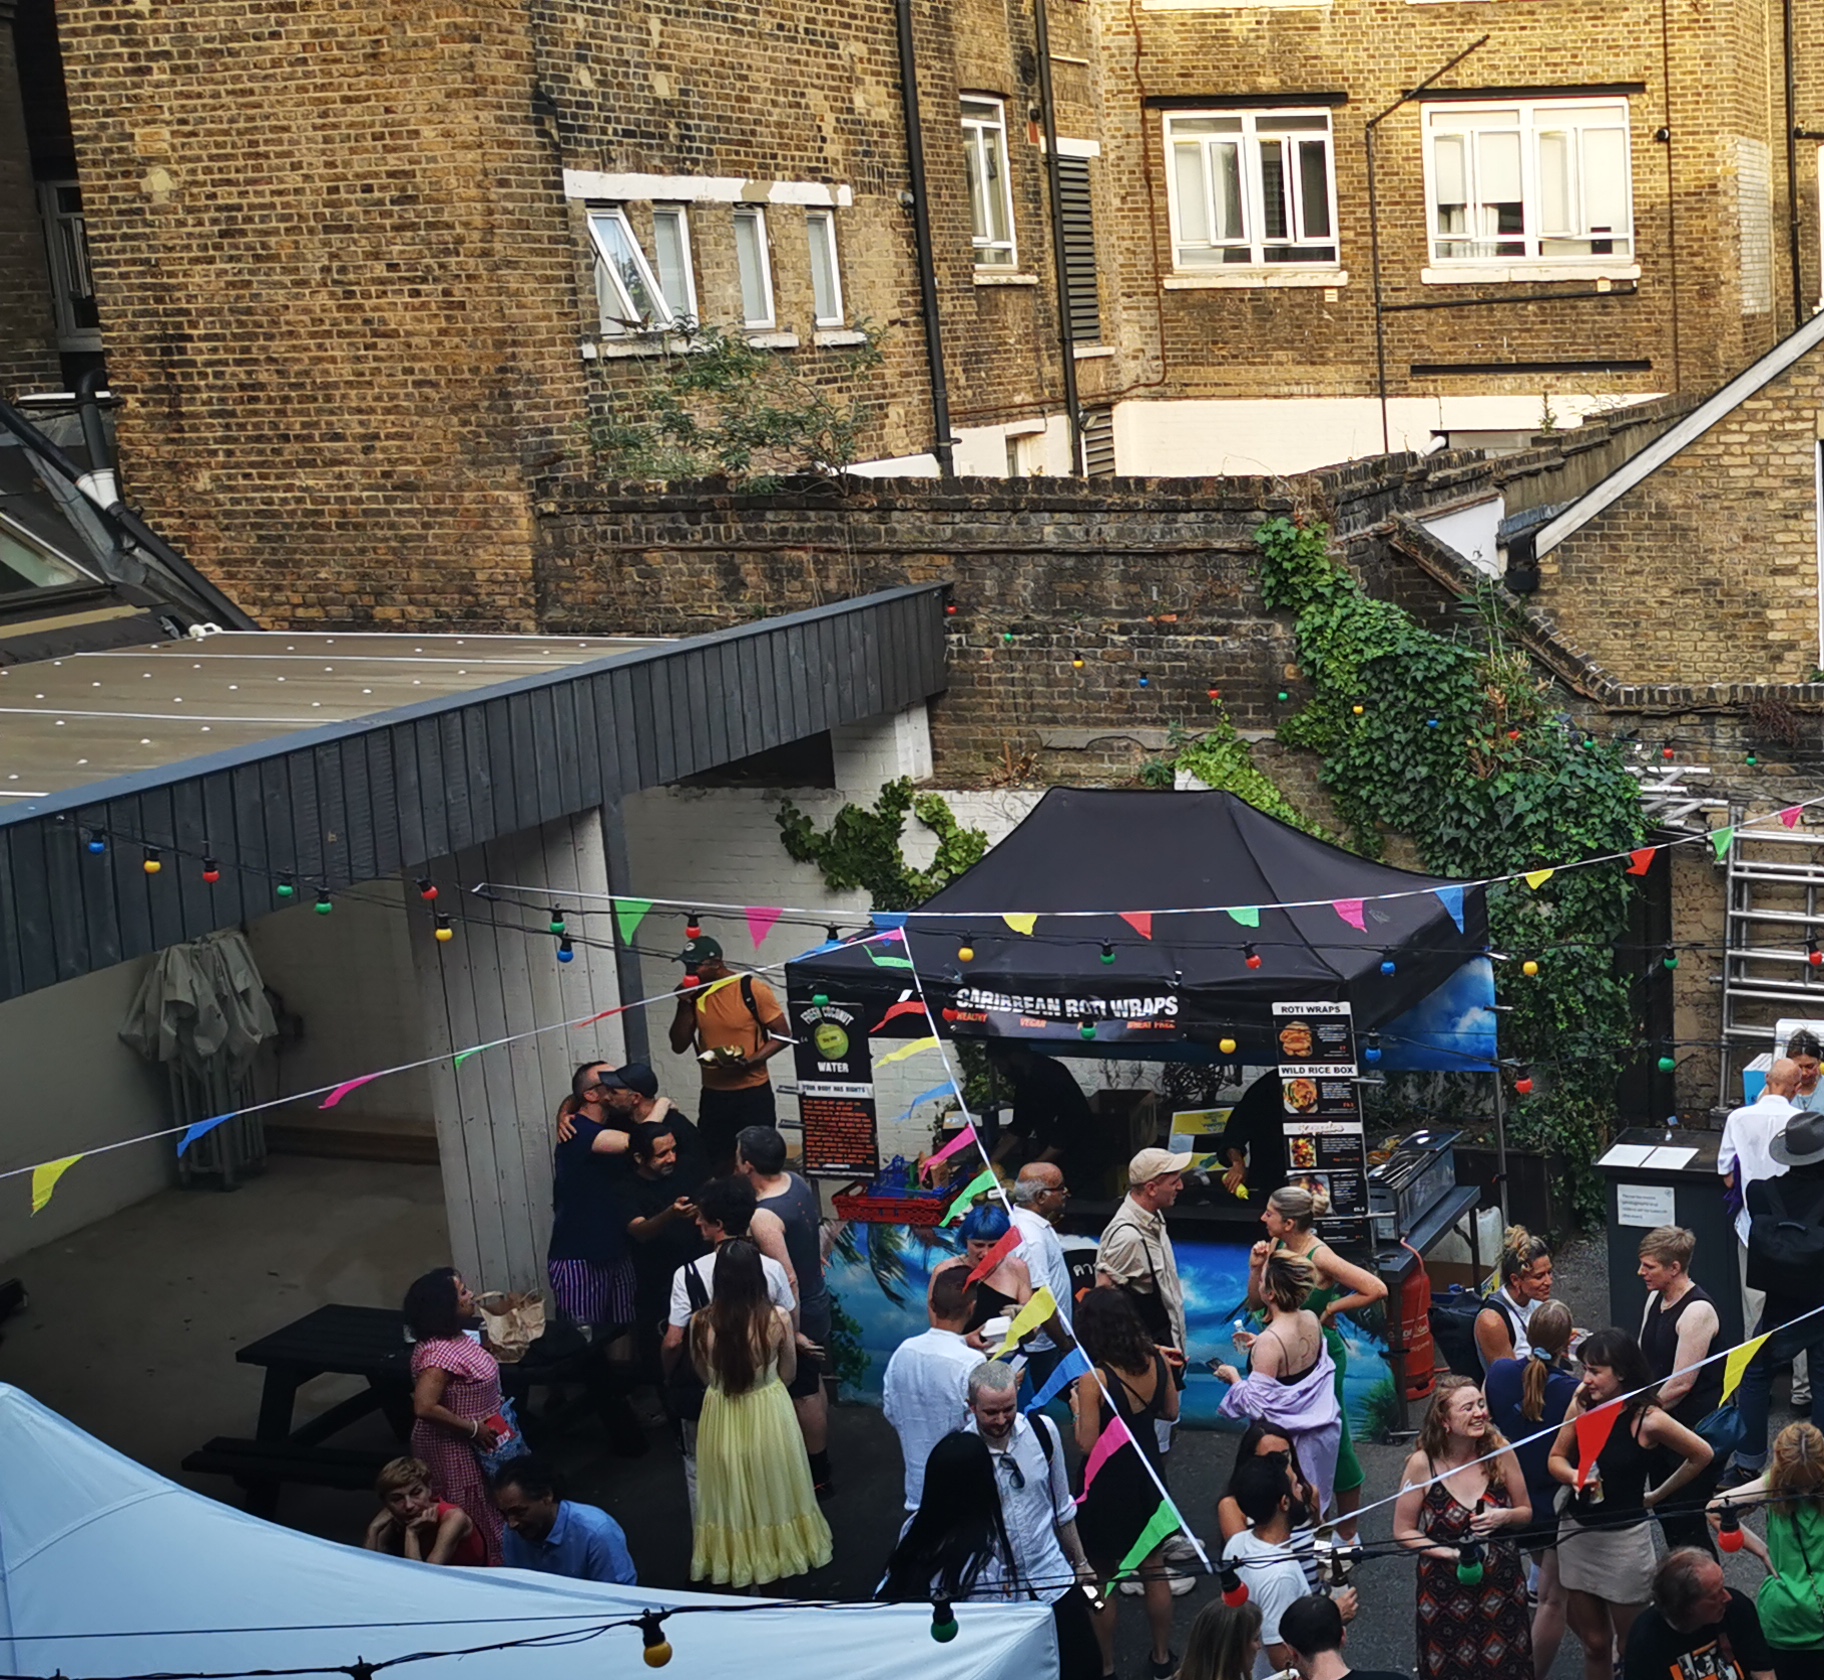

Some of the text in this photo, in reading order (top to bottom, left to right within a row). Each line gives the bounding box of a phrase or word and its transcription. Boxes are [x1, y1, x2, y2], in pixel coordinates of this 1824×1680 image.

[956, 987, 1178, 1018] CARIBBEAN ROTI WRAPS
[956, 1012, 988, 1022] HEALTHY
[1020, 1018, 1047, 1028] VEGAN
[817, 1062, 849, 1073] WATER
